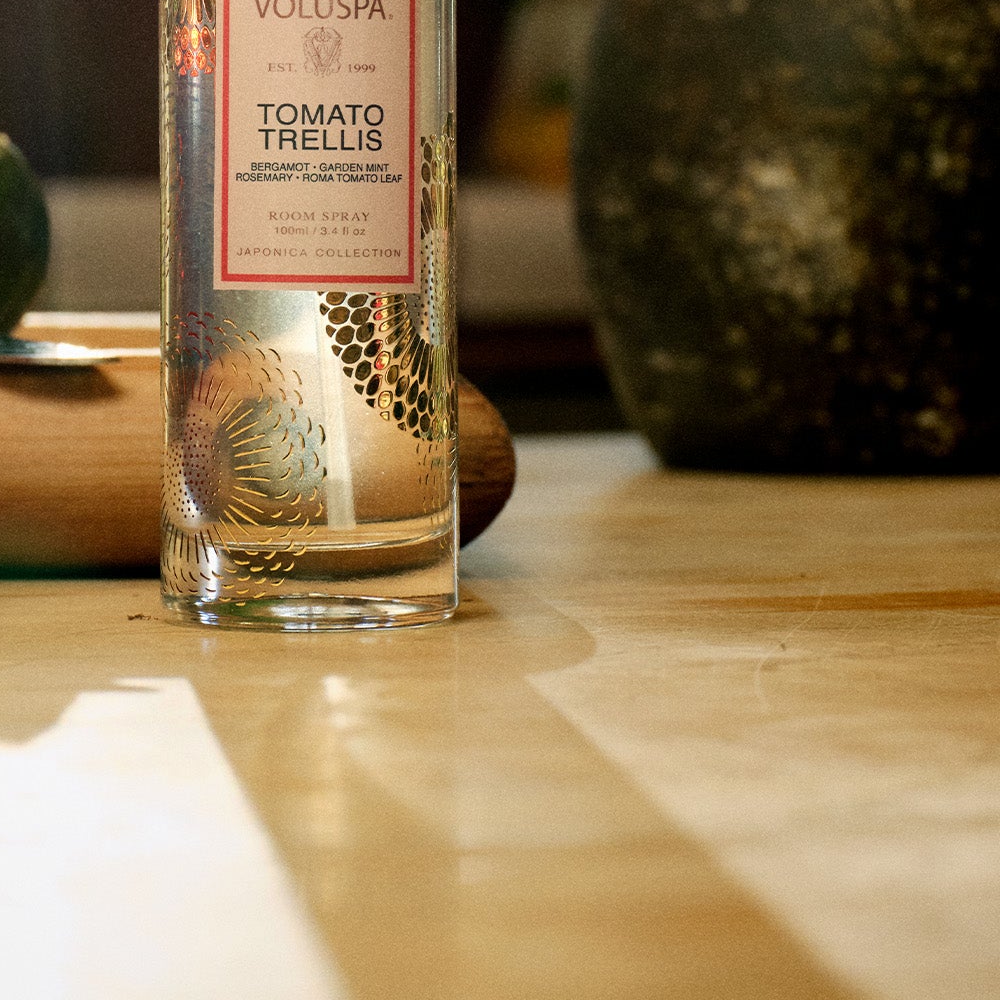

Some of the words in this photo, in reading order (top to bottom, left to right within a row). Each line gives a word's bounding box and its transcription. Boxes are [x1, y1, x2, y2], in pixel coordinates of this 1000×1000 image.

[267, 63, 297, 72] EST.
[348, 63, 375, 73] 1999
[257, 103, 384, 126] TOMATO
[258, 129, 383, 151] TRELLIS
[251, 162, 310, 172] BERGAMOT
[319, 163, 363, 172] GARDEN
[365, 163, 389, 172] MINT
[236, 172, 293, 182] ROSEMARY
[302, 173, 334, 183] ROMA
[337, 173, 378, 183] TOMATO
[380, 174, 403, 183] LEAF
[269, 211, 315, 221] ROOM
[322, 211, 370, 221] SPRAY
[275, 226, 309, 235] 100ml
[320, 226, 338, 235] 3.4
[353, 228, 366, 236] oz
[236, 247, 308, 257] JAPONICA
[315, 248, 401, 258] COLLECTION
